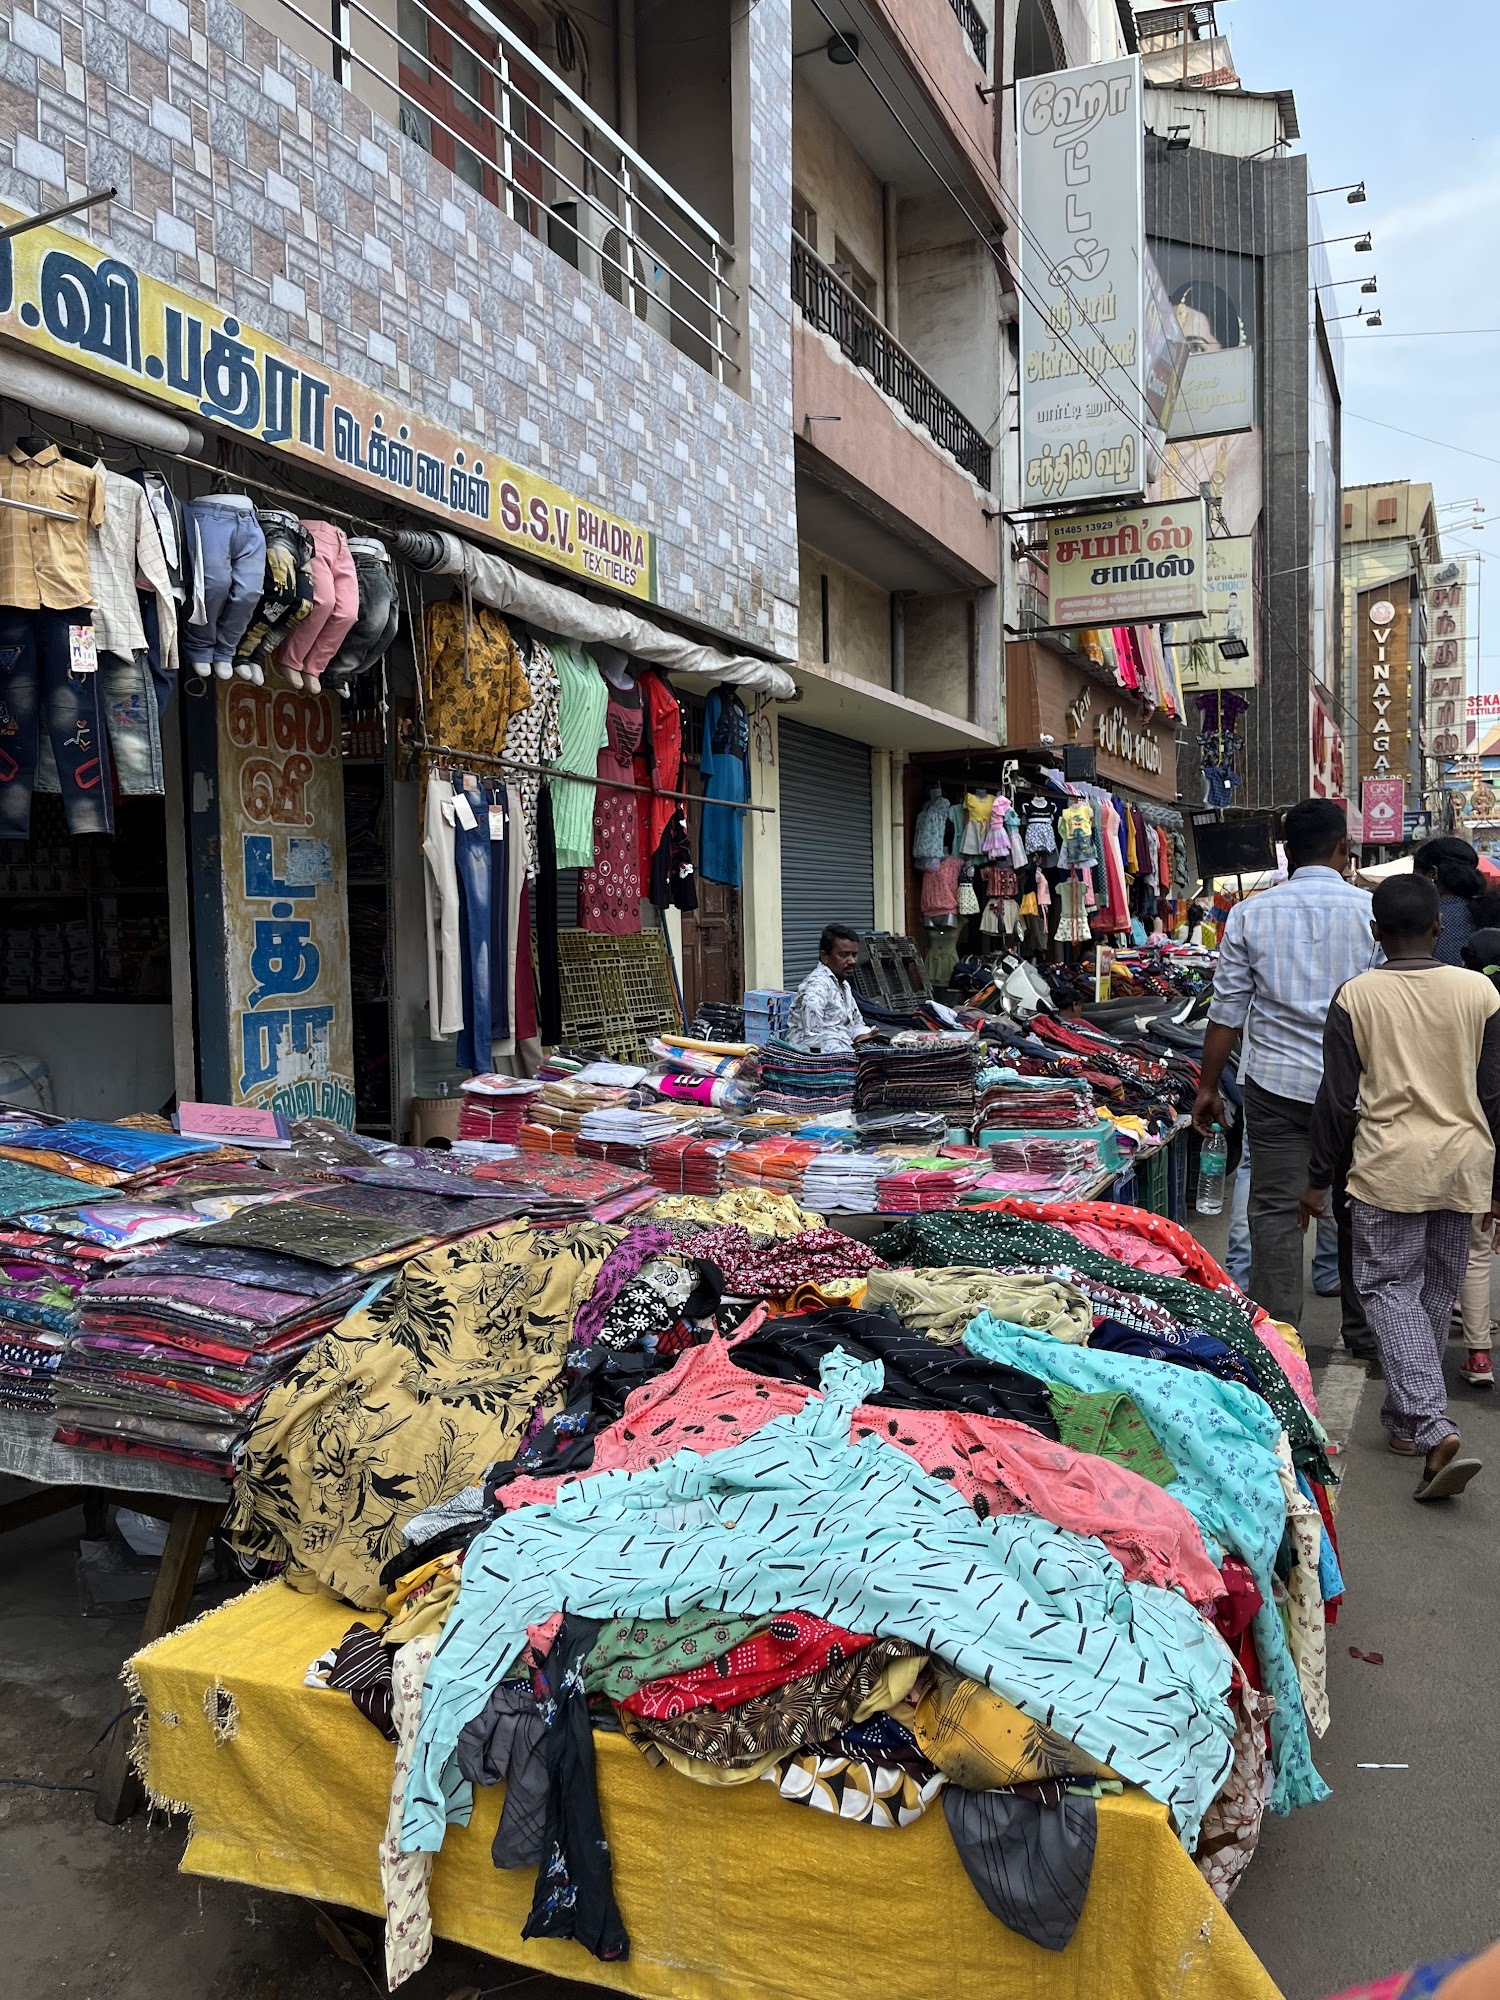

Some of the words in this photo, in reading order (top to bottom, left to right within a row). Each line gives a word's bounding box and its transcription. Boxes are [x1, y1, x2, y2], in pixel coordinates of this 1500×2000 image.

[0, 238, 331, 452] .வி.பத்ரா
[501, 483, 574, 554] S.S.V.
[578, 507, 645, 568] BHADRA
[1054, 525, 1082, 536] 81485
[1085, 521, 1113, 532] 13929
[1091, 554, 1195, 585] சாய்ஸ்
[1217, 580, 1246, 592] CHOICE
[1372, 628, 1392, 770] VINAYAGA
